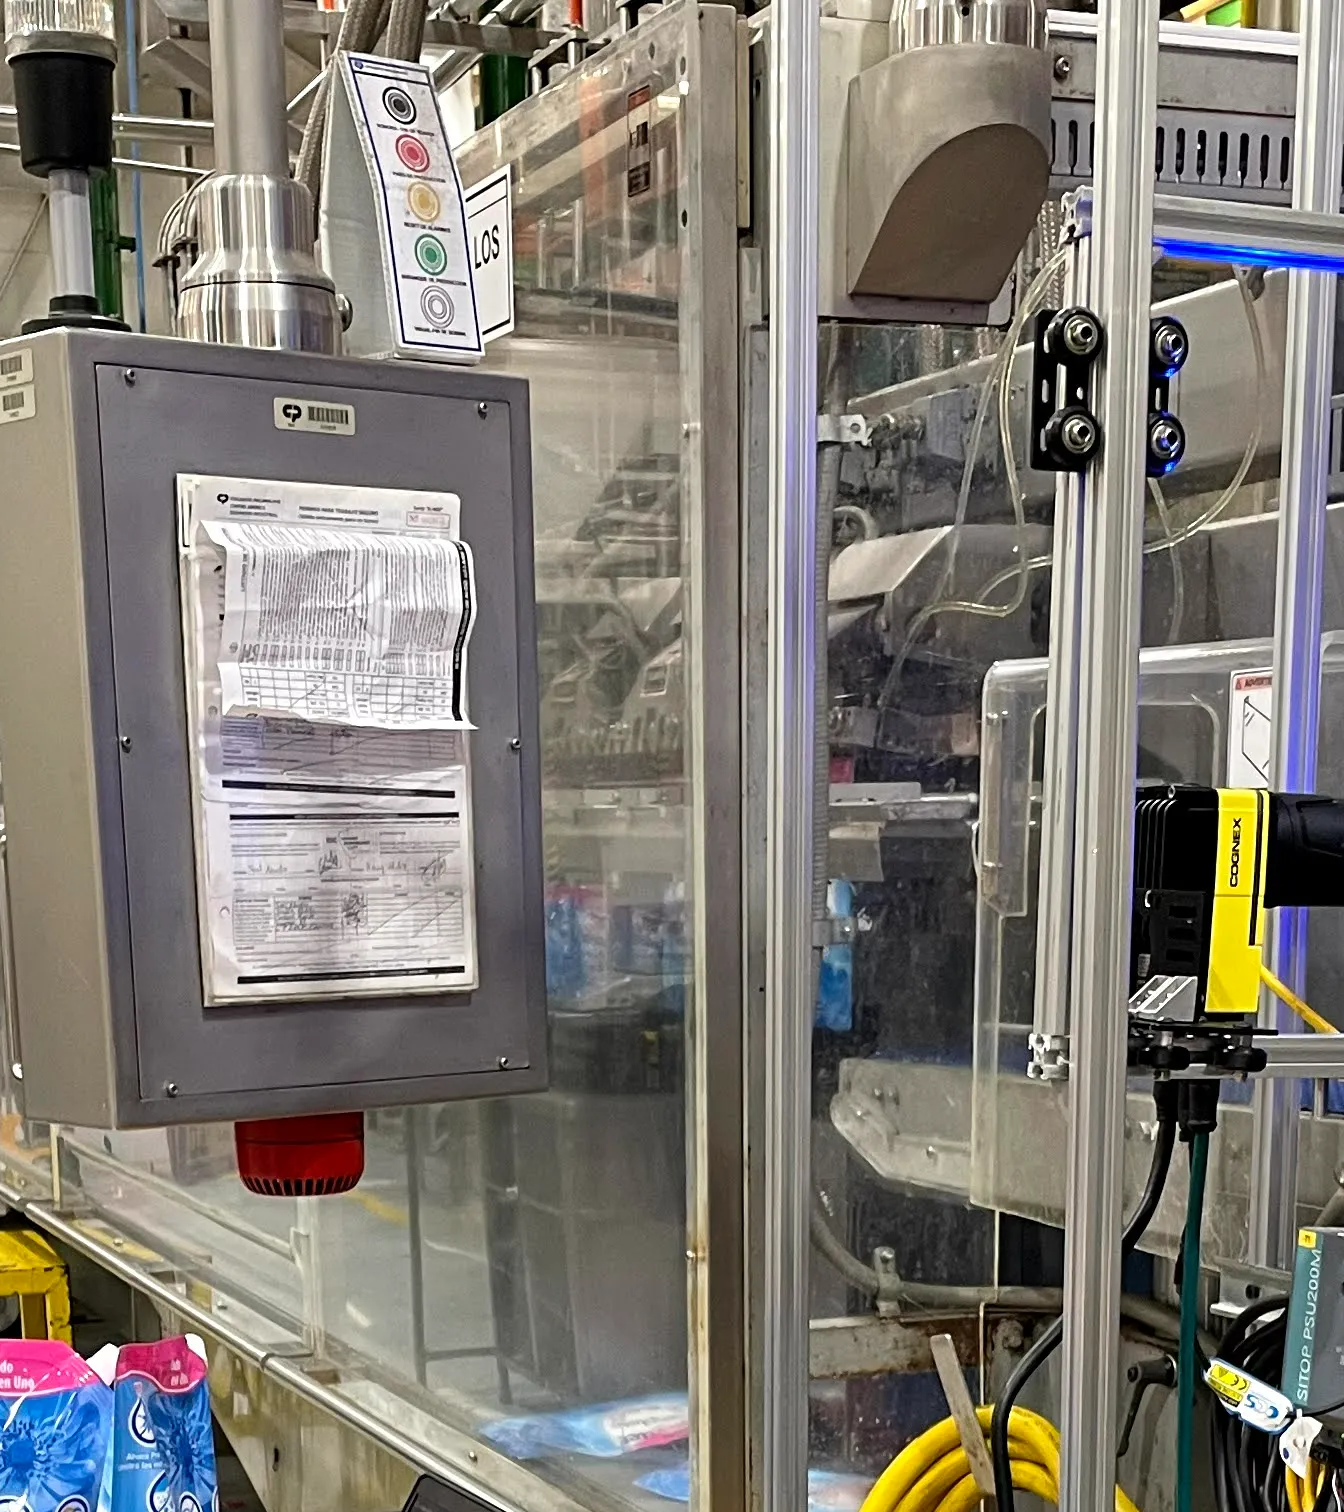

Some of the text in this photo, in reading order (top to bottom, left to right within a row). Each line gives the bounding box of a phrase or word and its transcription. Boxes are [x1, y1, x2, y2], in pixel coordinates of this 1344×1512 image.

[1230, 817, 1242, 888] COGNEX
[1302, 1249, 1322, 1340] PSU200M
[14, 1376, 35, 1390] Uno
[1297, 1346, 1313, 1402] SITOP
